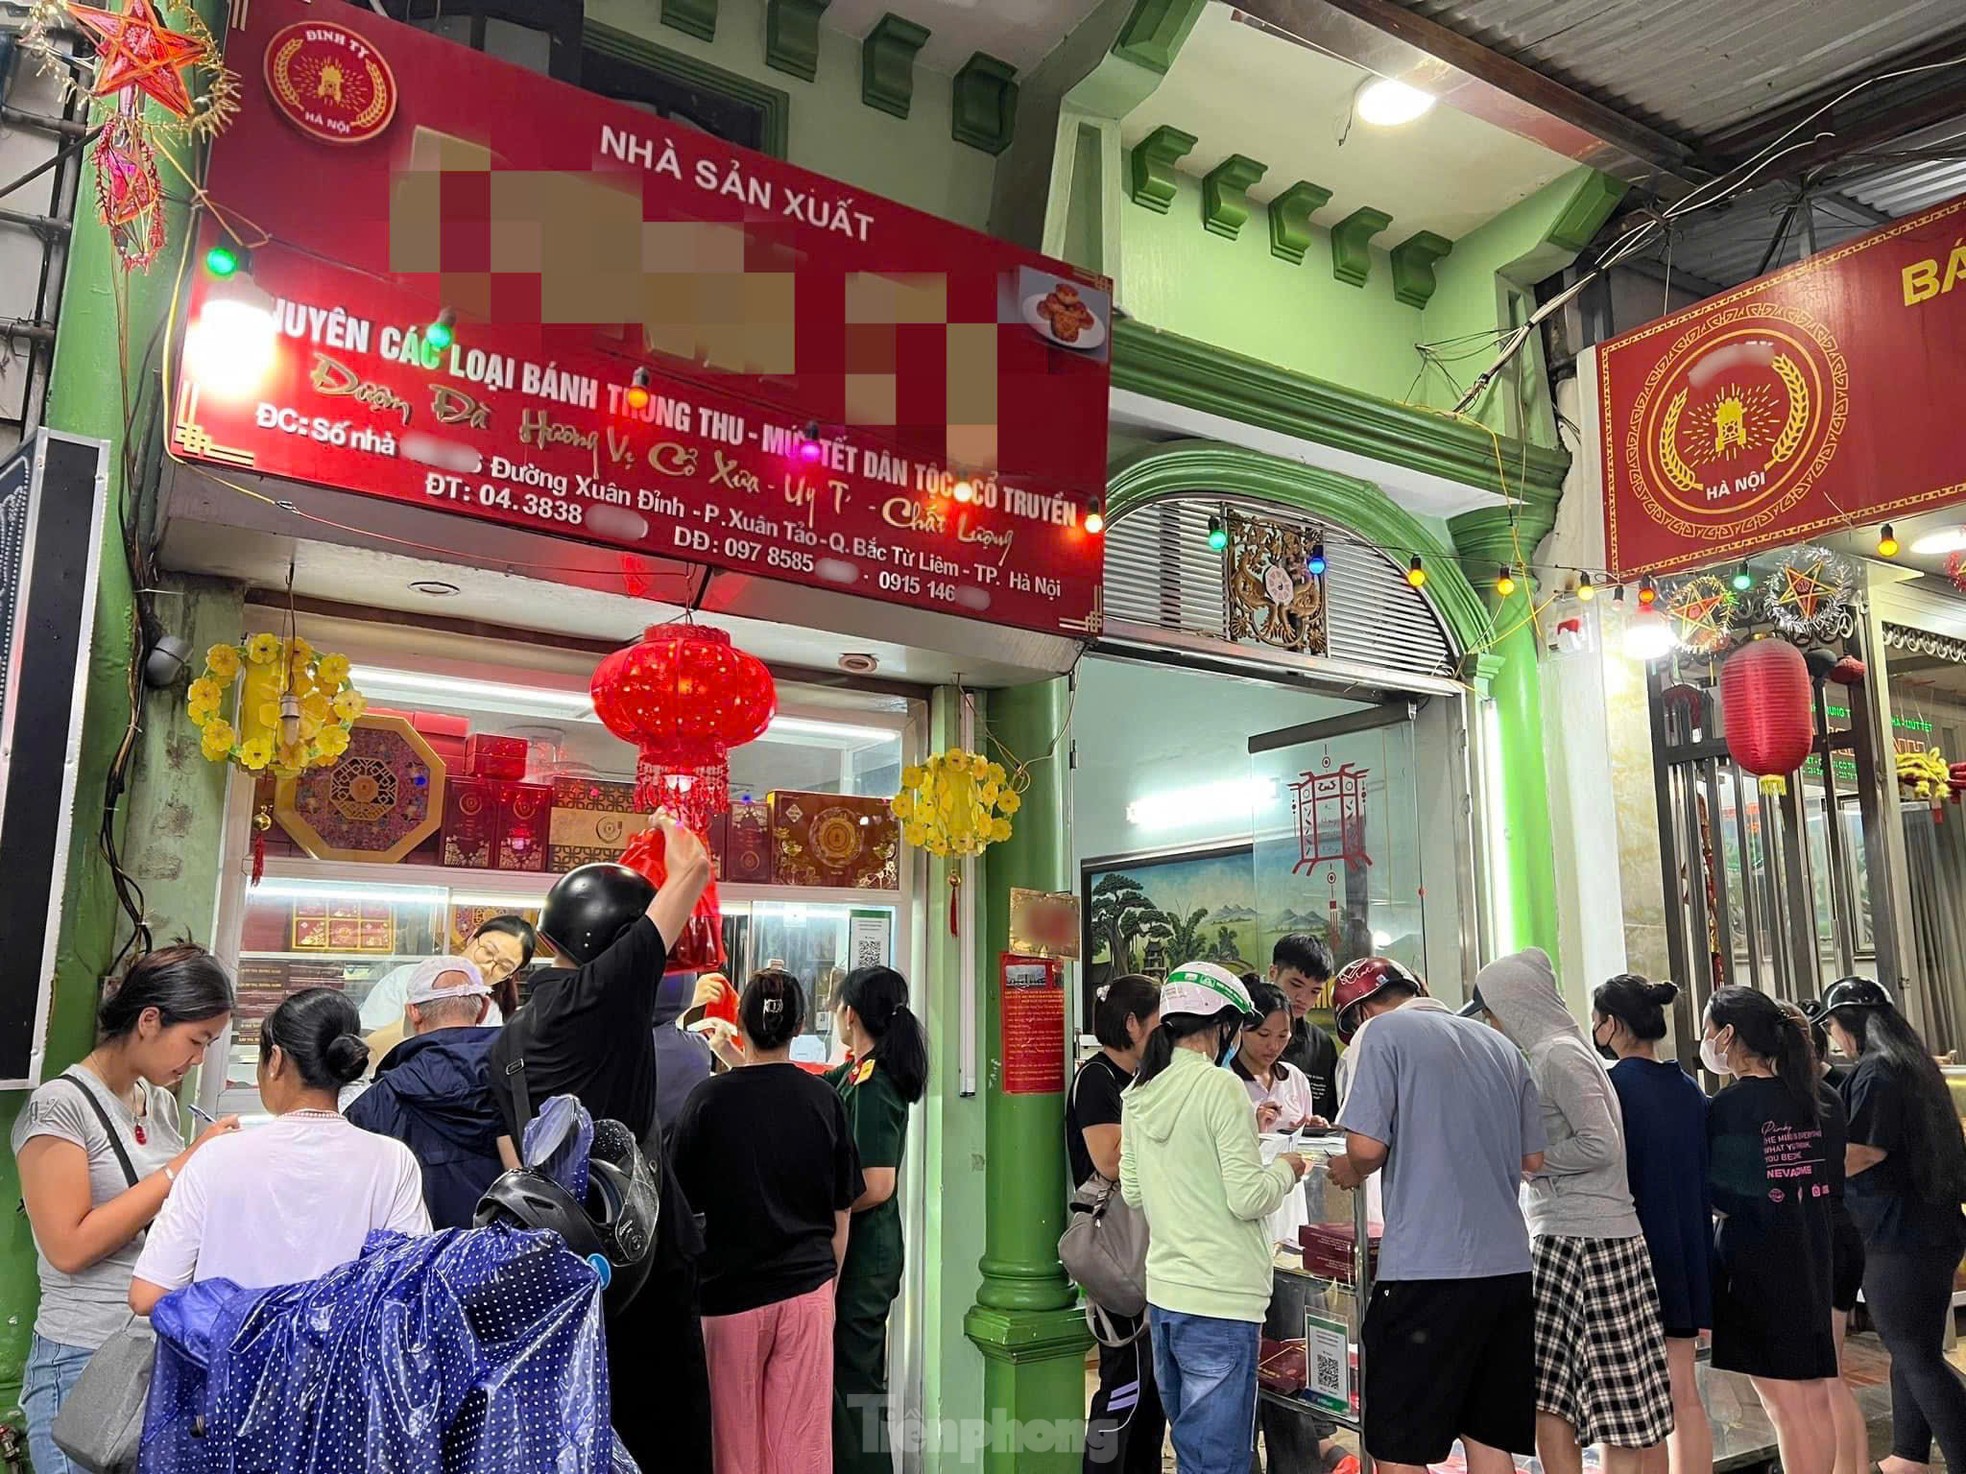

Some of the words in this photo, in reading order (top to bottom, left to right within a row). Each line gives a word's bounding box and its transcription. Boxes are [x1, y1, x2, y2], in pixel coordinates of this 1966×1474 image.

[326, 117, 351, 134] NỘI
[600, 125, 682, 181] NHÀ
[694, 159, 772, 211] SẢN
[782, 188, 875, 242] XUẤT
[379, 325, 441, 370] CÁC
[449, 344, 516, 393] LOẠI
[521, 361, 599, 411] BÁNH
[606, 383, 692, 433] TRUNG
[698, 406, 745, 446] THU
[820, 435, 858, 474] TẾT
[863, 449, 908, 488] DÂN
[914, 462, 954, 500] TỘC
[972, 471, 998, 509] CỔ
[1003, 487, 1077, 528] TRUYỀN
[428, 382, 493, 430] Đà
[518, 408, 600, 481] Hương
[606, 425, 636, 471] Vị
[648, 441, 699, 477] Cổ
[708, 449, 761, 494] Xưa
[784, 472, 817, 529] Uy
[881, 497, 947, 534] Chất
[957, 513, 1014, 568] Lượng
[350, 425, 397, 456] nhà
[490, 451, 568, 496] Đường
[575, 474, 631, 507] Xuân
[636, 488, 686, 518] Đỉnh
[853, 536, 887, 562] Bắc
[891, 545, 915, 568] Từ
[918, 551, 959, 577] Liêm
[974, 563, 1002, 586] TP.
[1009, 571, 1031, 592] Hà
[1034, 577, 1062, 601] Nội
[425, 471, 471, 496] ĐT:
[1706, 480, 1731, 501] HÀ
[1735, 471, 1766, 492] NỘI
[673, 525, 719, 554] DĐ:
[724, 537, 762, 562] 097
[767, 548, 815, 573] 8585
[879, 571, 921, 596] 0915
[927, 582, 956, 602] 146
